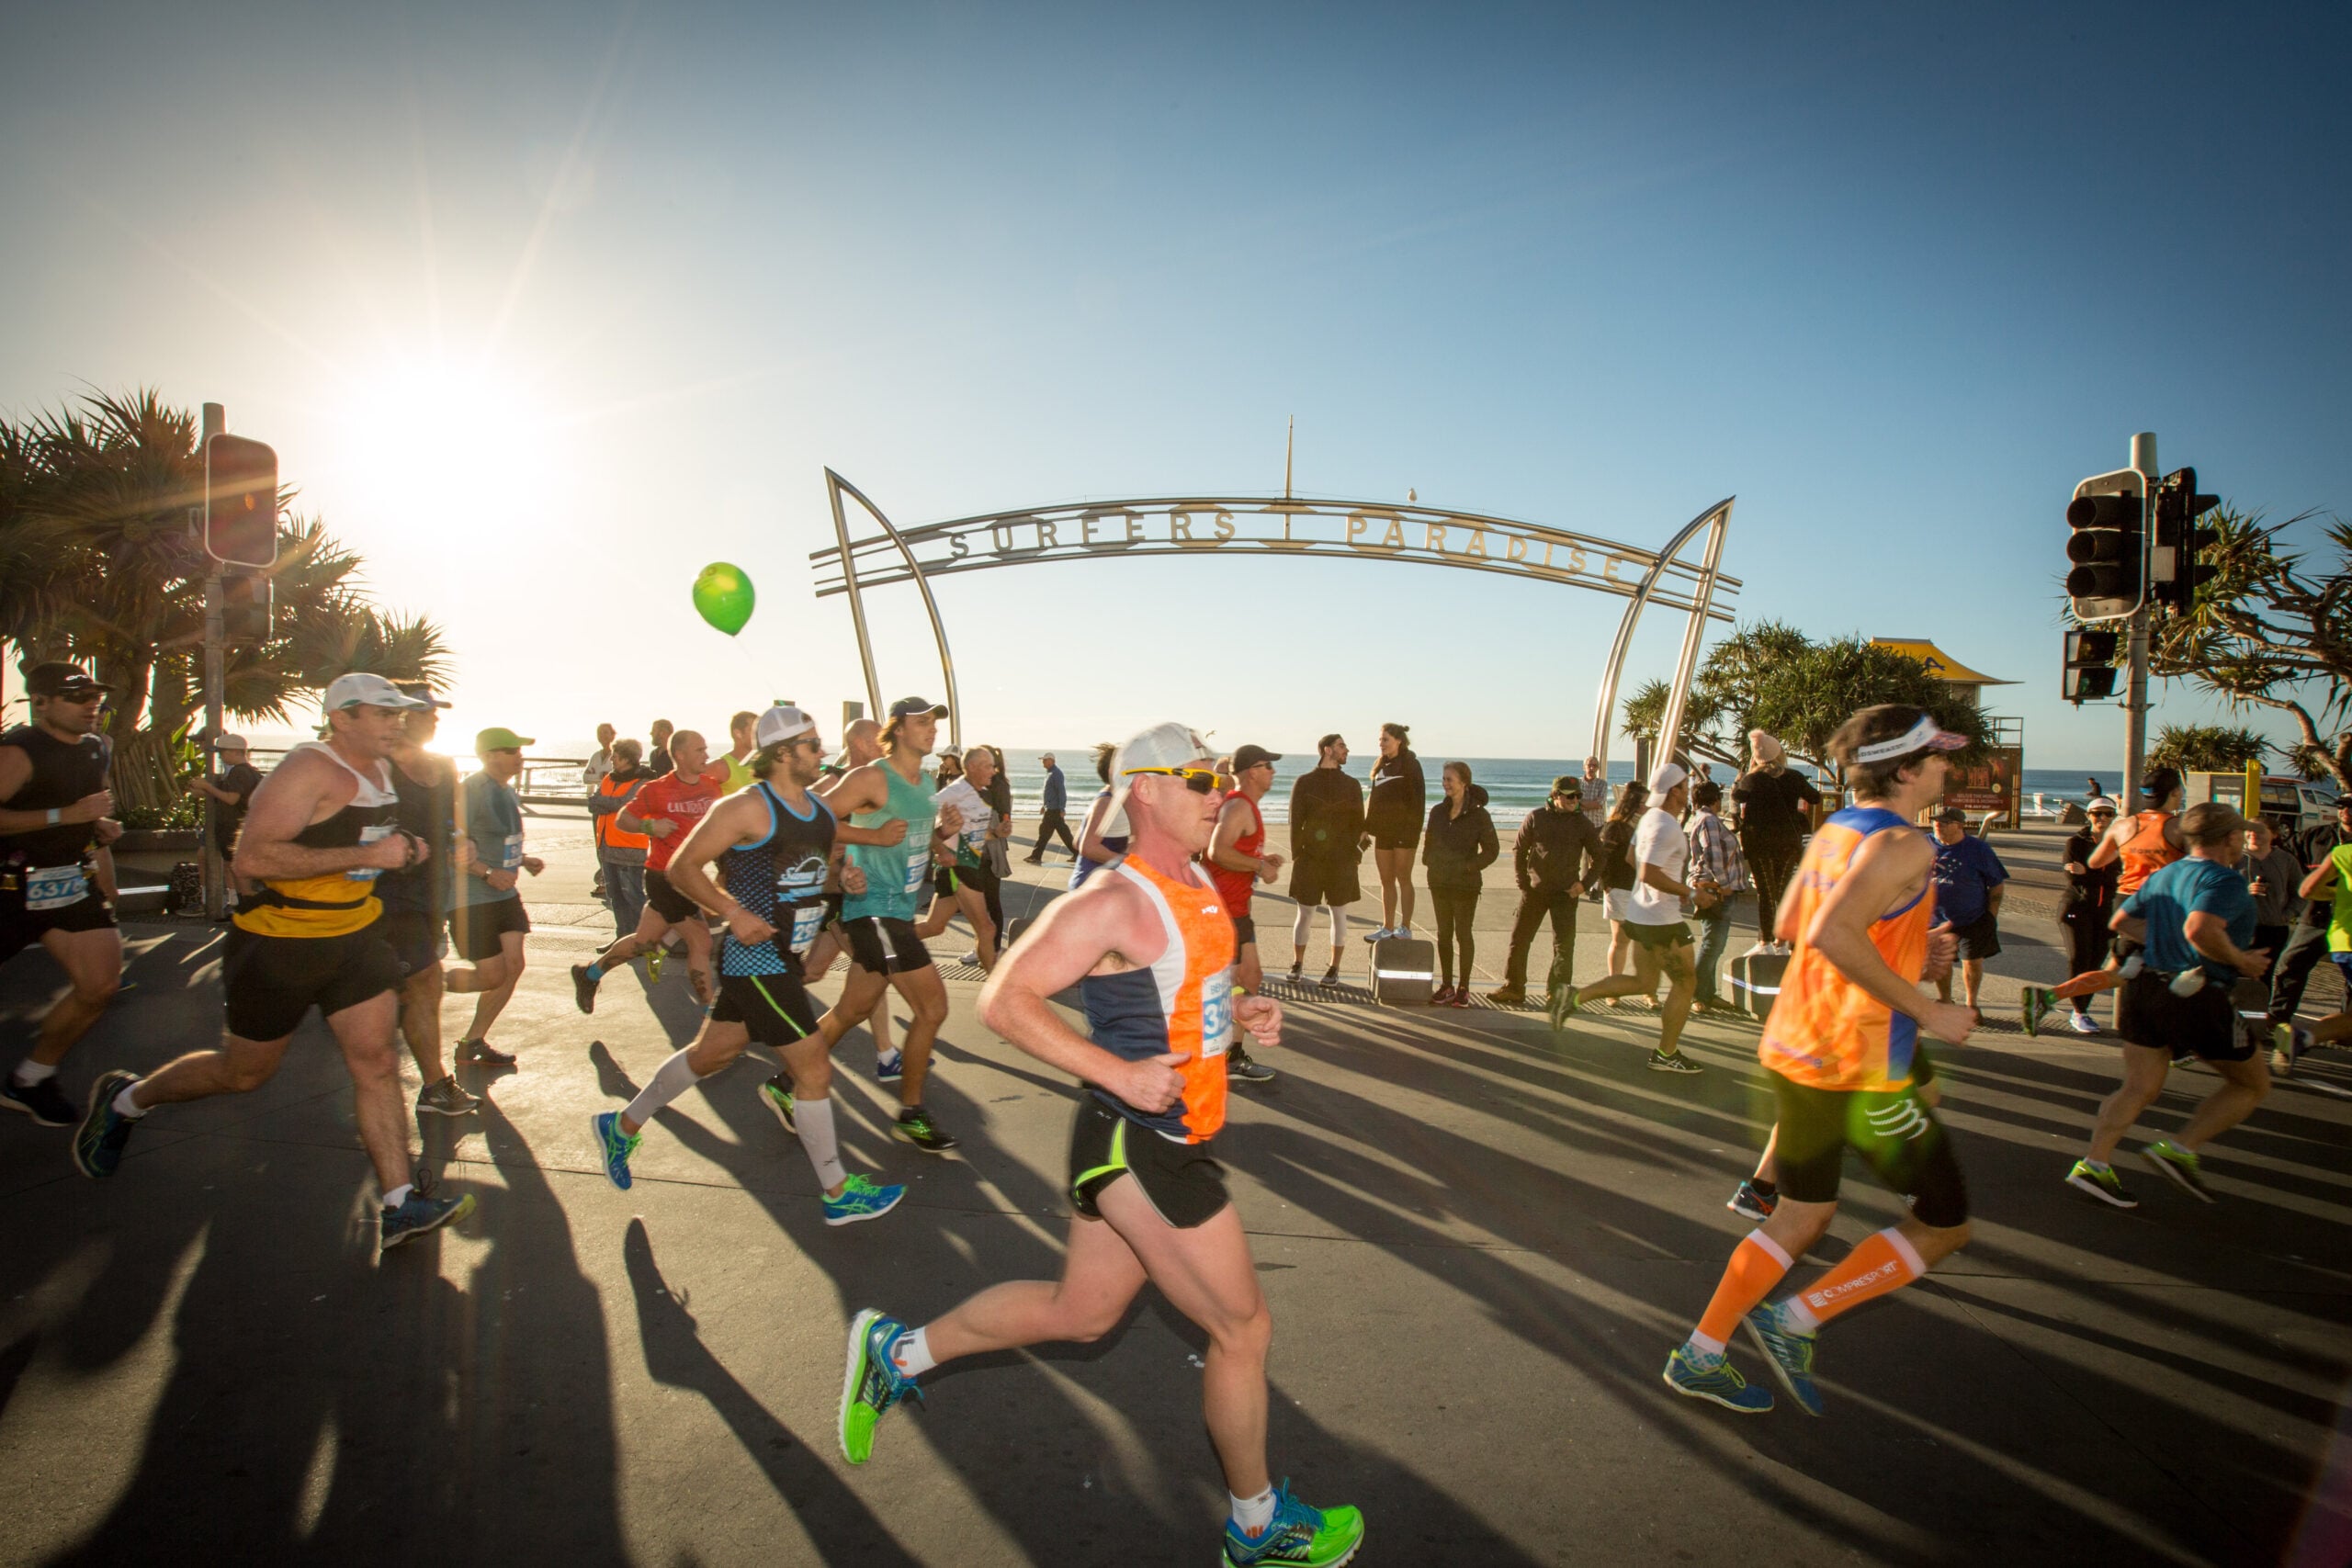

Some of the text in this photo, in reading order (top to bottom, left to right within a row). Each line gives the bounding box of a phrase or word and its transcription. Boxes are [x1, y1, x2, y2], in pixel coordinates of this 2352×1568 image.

[950, 512, 1623, 583] SURFERS PARADISE
[1823, 1259, 1897, 1298] COMPRESSPORT
